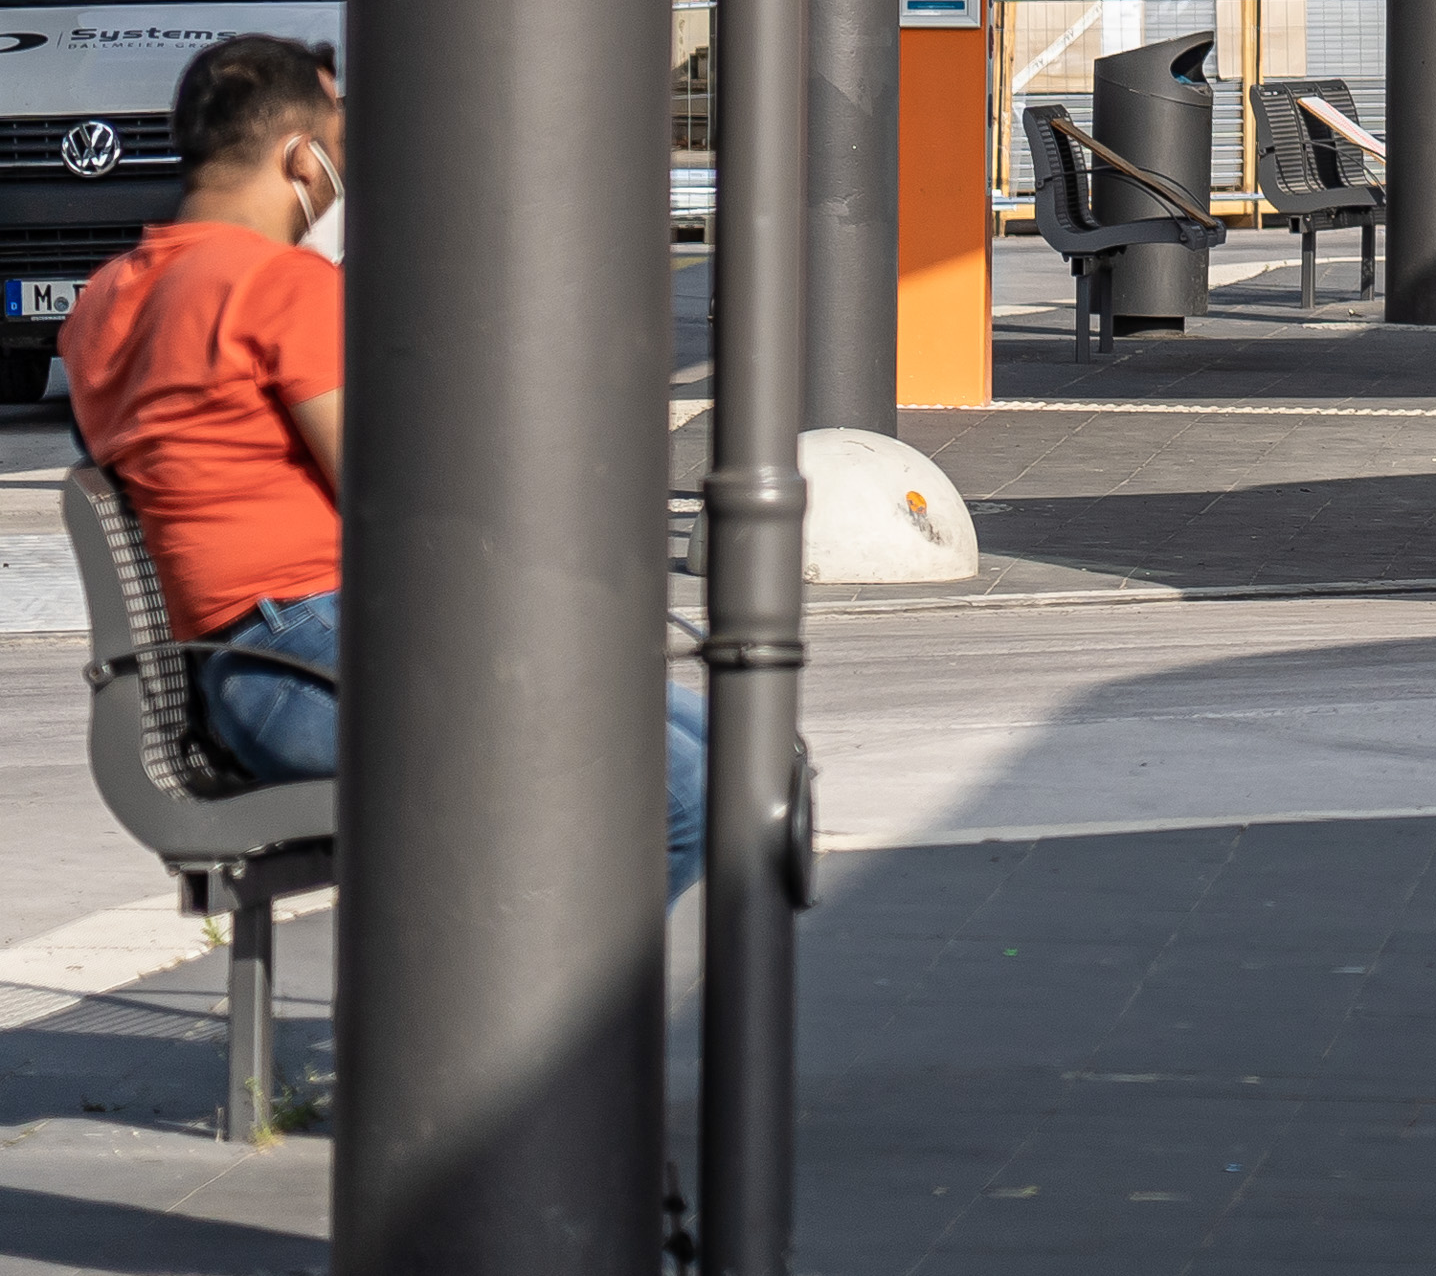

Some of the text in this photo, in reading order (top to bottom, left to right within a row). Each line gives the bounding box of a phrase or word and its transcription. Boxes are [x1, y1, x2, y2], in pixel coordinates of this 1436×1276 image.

[71, 27, 238, 42] Systems
[10, 301, 18, 311] D
[33, 283, 53, 312] M
